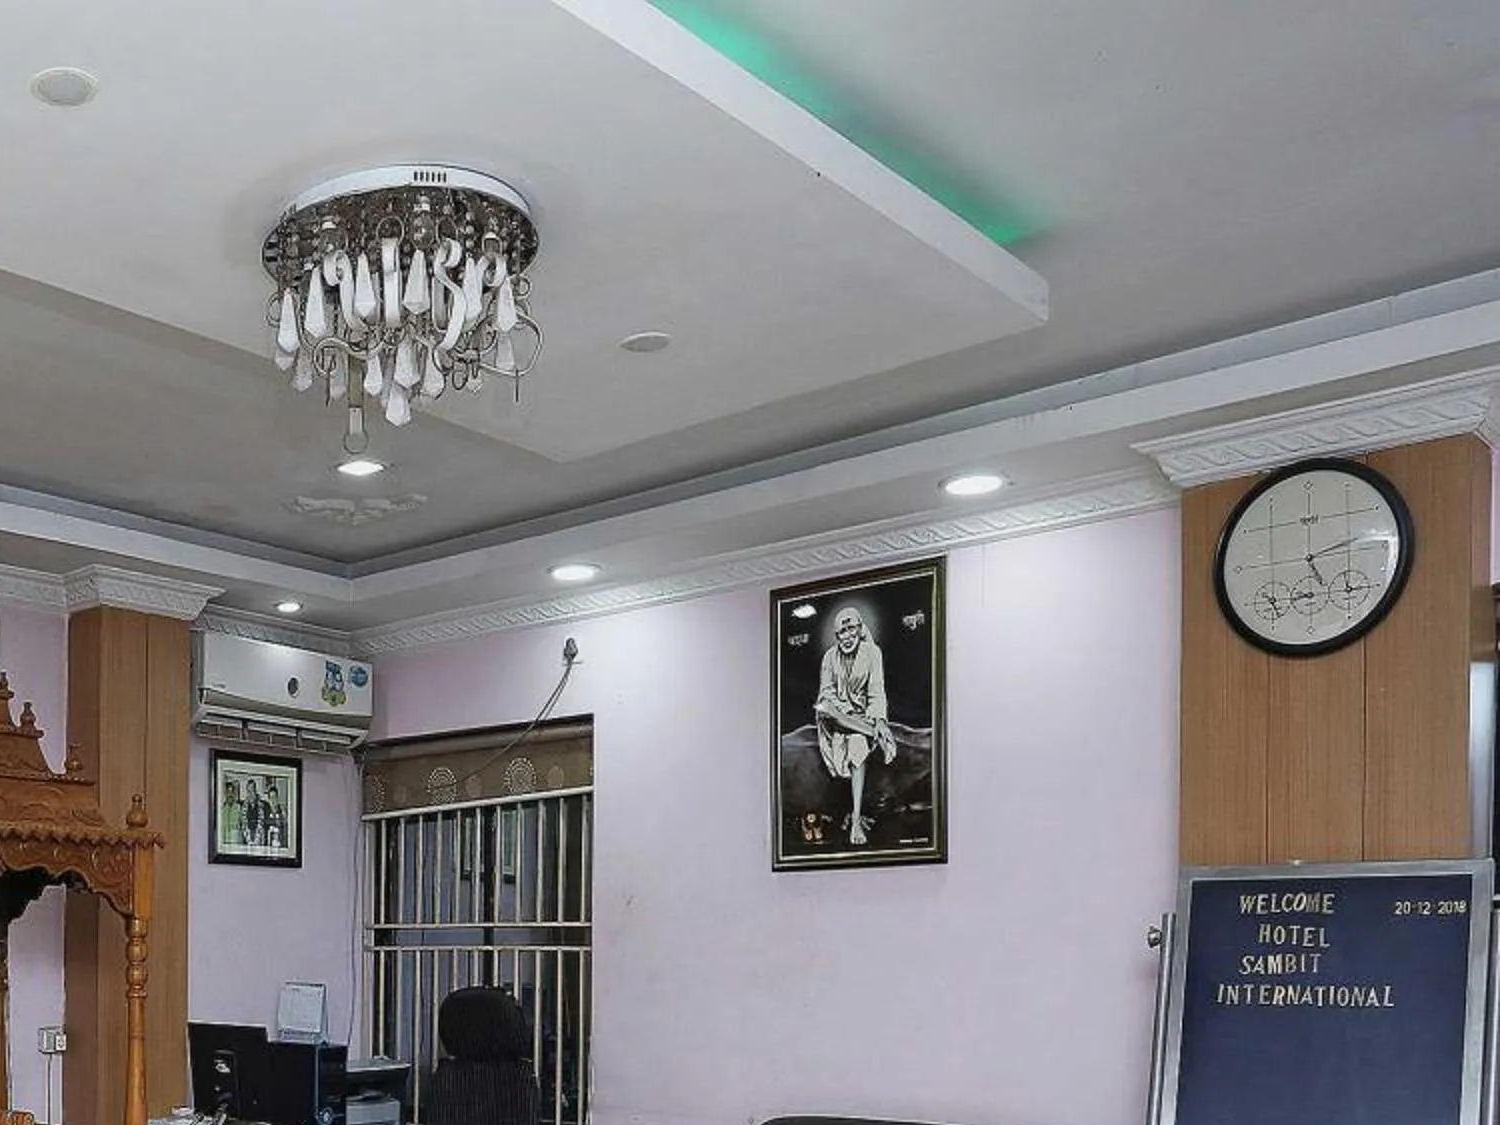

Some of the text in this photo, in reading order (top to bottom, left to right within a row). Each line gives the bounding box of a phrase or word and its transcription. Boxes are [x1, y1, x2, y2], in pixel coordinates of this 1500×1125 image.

[1238, 892, 1336, 916] WELCOME
[1258, 923, 1332, 948] HOTEL
[1238, 953, 1322, 976] SAMBIT
[1216, 983, 1396, 1008] INTERNATIONAL
